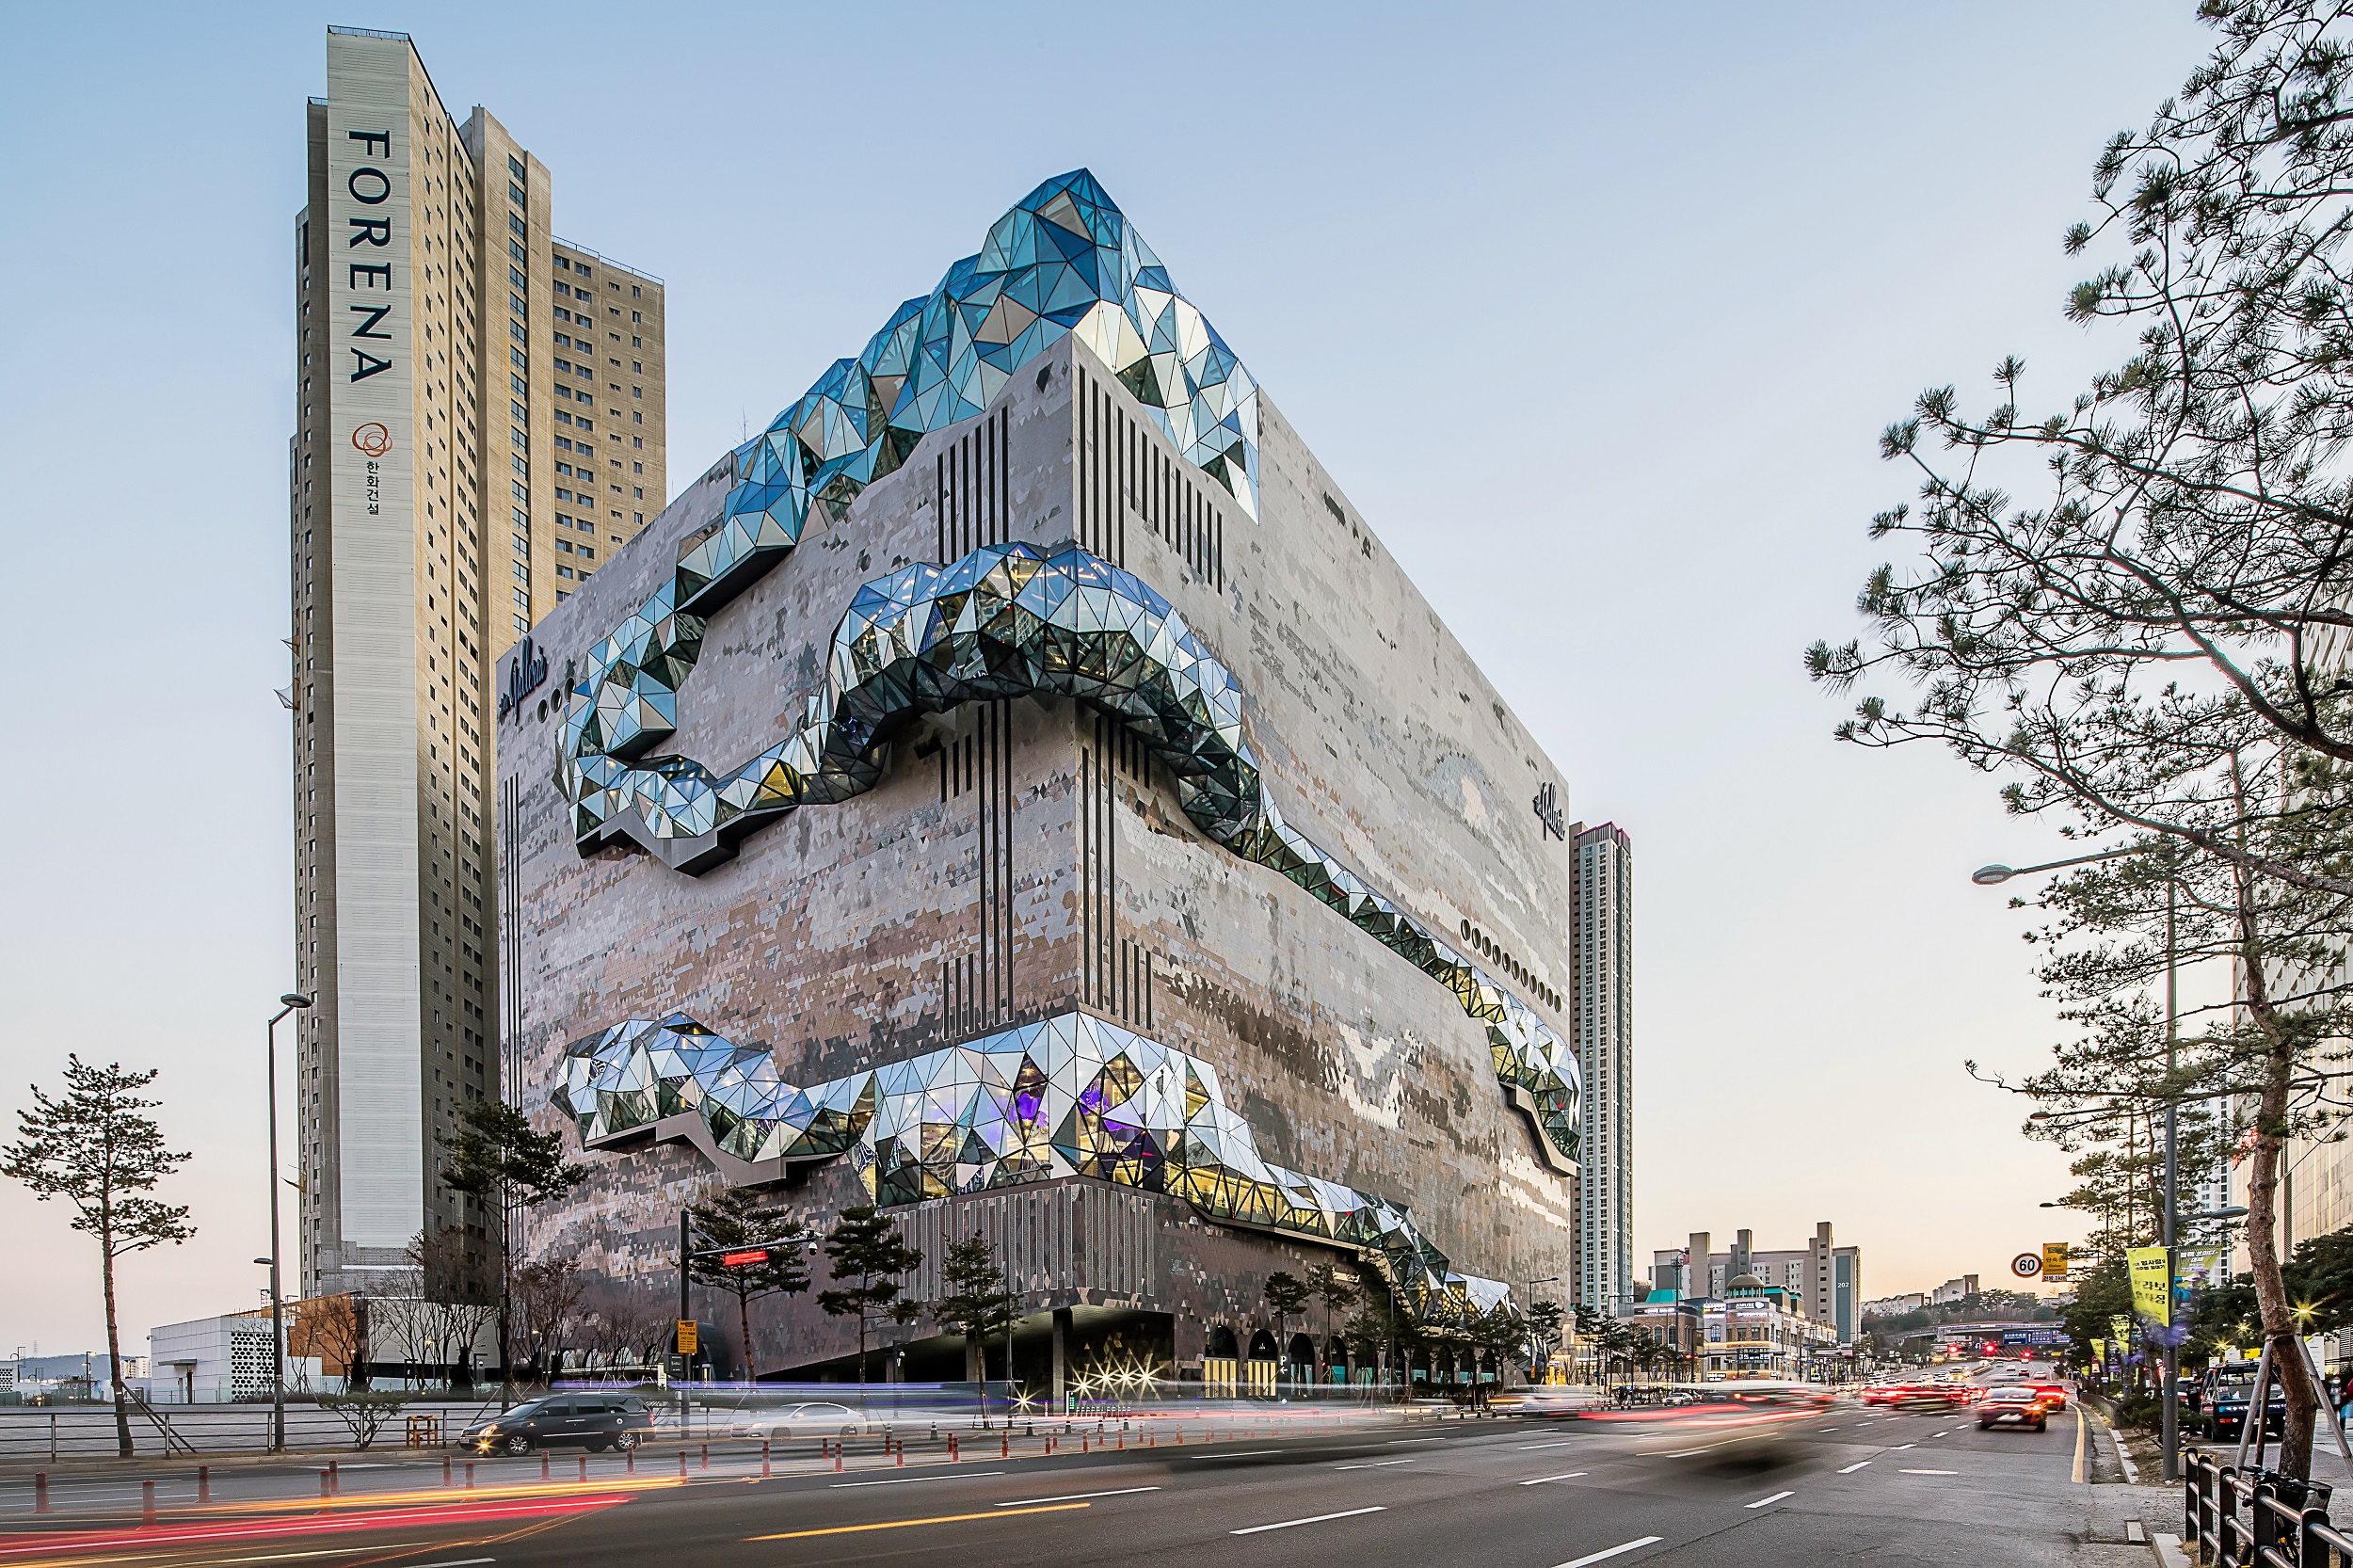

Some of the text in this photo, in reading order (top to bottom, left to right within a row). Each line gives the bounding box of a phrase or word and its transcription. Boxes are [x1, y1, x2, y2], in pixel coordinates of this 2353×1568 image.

[348, 130, 392, 383] FORENA
[366, 461, 380, 515] 한화건설
[2019, 1259, 2035, 1271] 60
[1280, 1355, 1288, 1366] P
